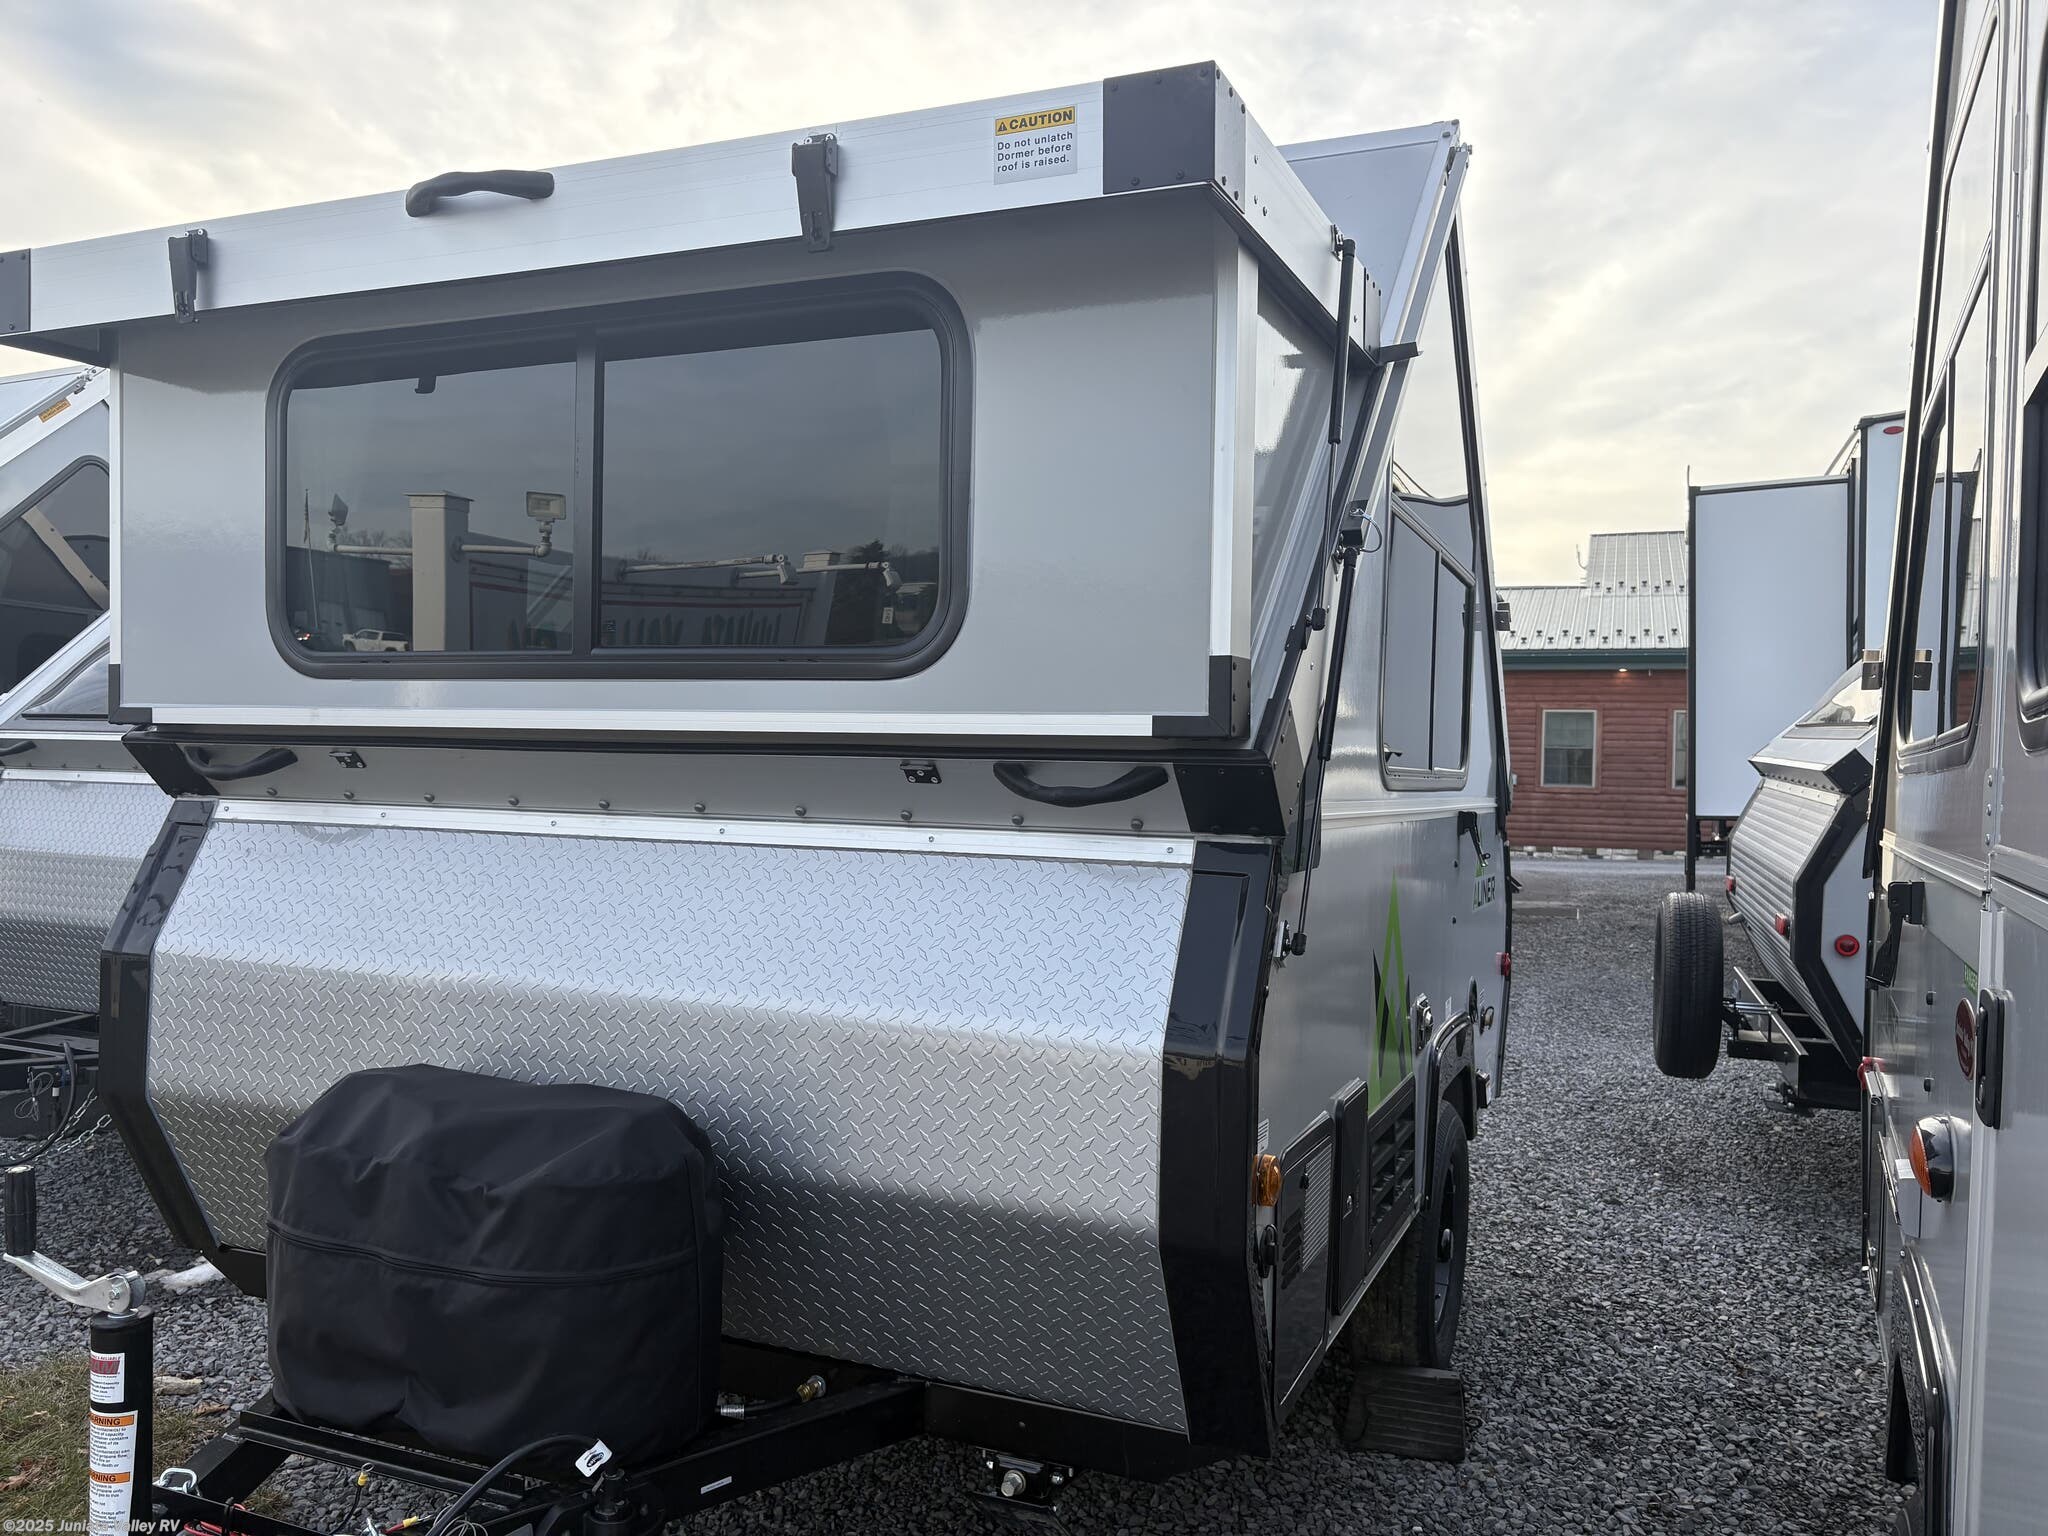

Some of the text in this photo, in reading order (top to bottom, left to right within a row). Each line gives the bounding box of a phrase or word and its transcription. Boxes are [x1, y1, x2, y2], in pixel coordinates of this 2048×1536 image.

[1009, 110, 1073, 129] CAUTION
[997, 131, 1073, 151] Do not unlatch
[997, 143, 1072, 162] Dormer before
[997, 154, 1070, 173] roof is raised.
[1473, 877, 1495, 910] ALINER
